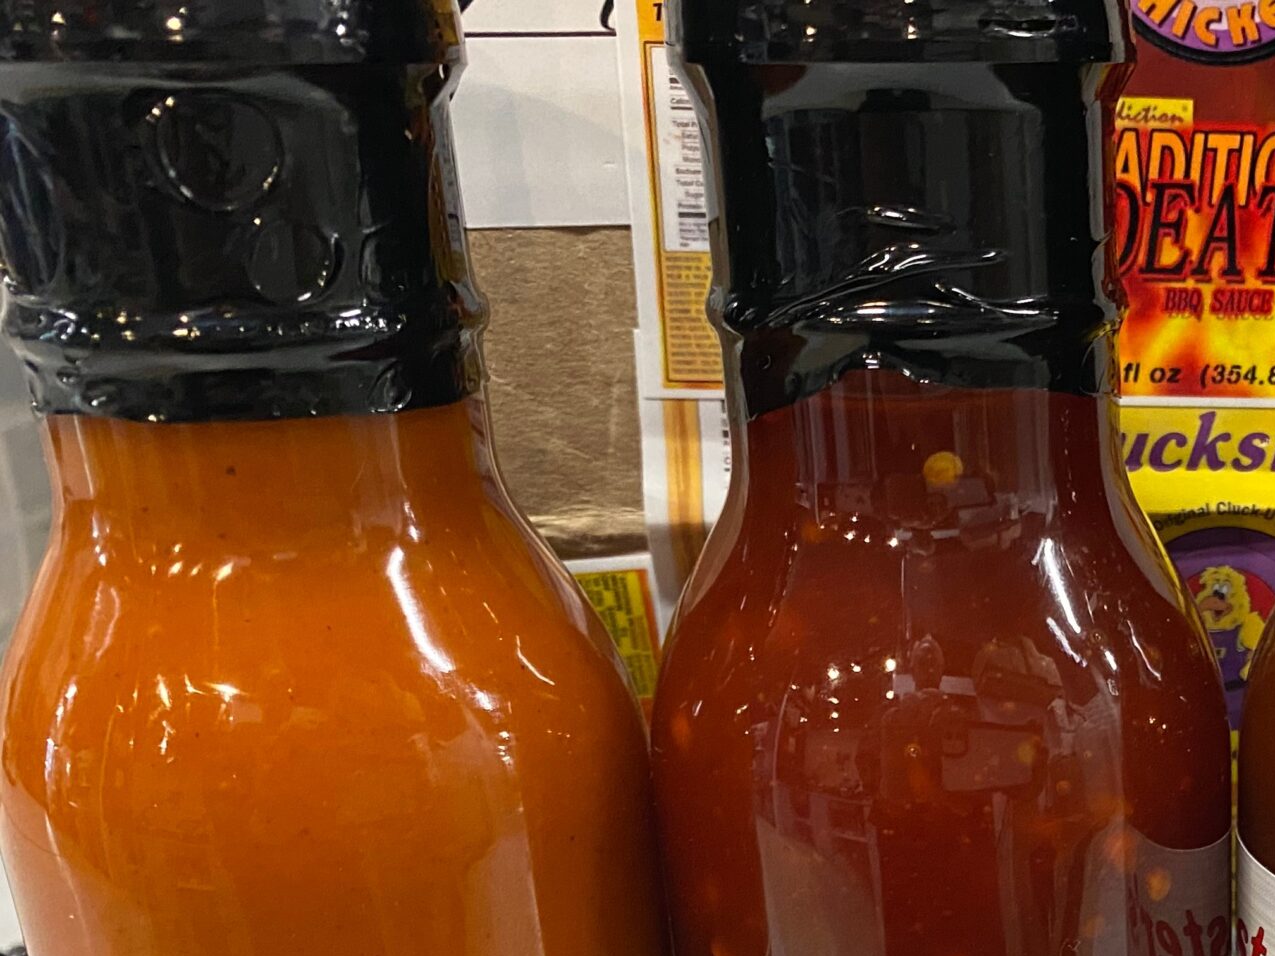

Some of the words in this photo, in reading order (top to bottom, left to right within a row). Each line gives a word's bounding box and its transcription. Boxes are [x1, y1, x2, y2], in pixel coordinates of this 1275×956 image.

[1163, 288, 1203, 319] BBQ
[1211, 288, 1275, 320] SAUCE
[1123, 362, 1142, 383] fl
[1149, 366, 1182, 384] oz
